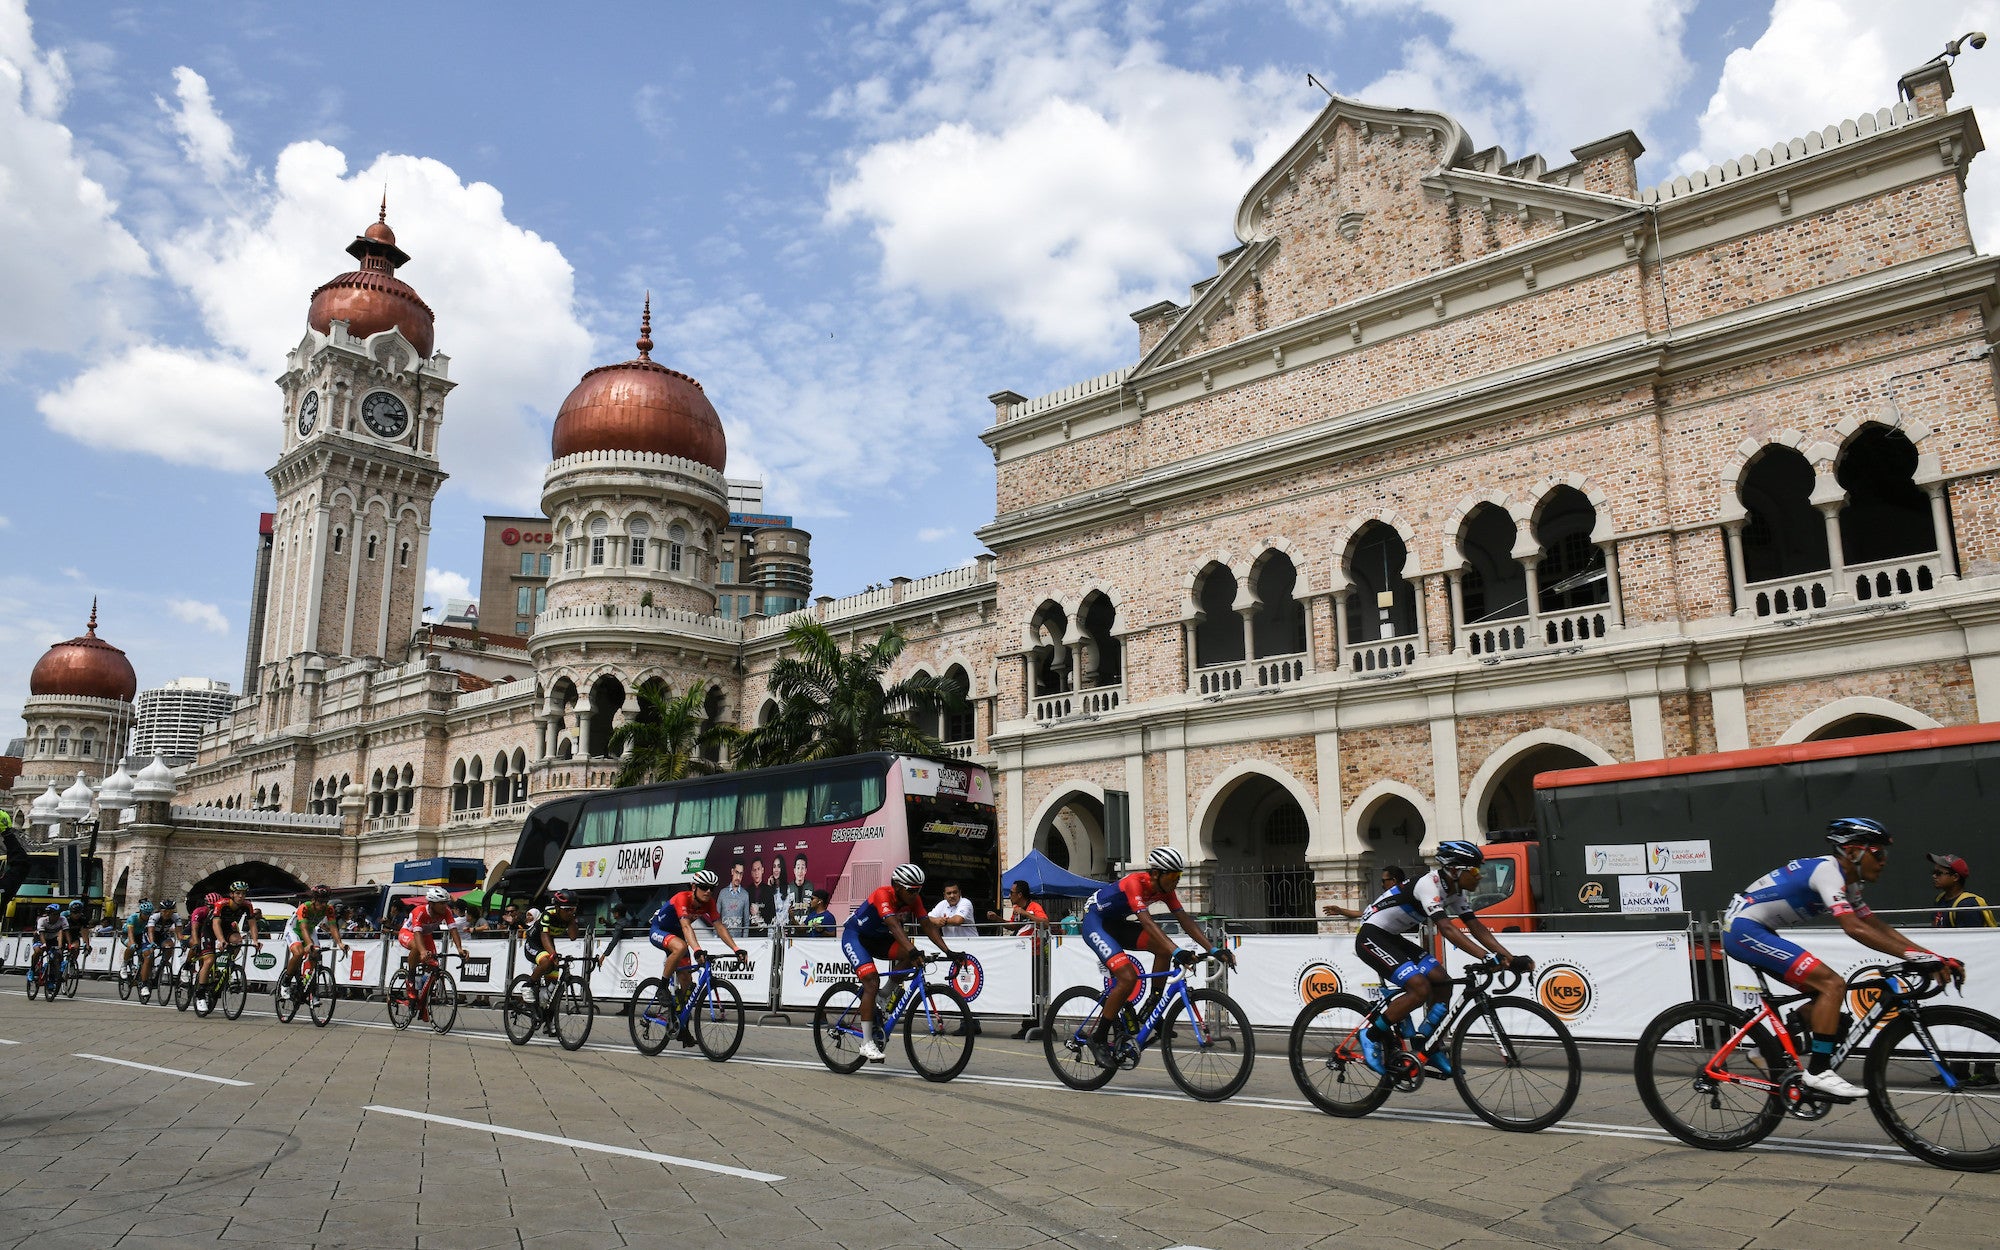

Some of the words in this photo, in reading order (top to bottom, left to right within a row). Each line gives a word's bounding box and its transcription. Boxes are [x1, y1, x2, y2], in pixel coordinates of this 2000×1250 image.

[910, 768, 929, 779] TV3
[617, 847, 651, 869] DRAMA
[1671, 851, 1706, 860] LANGKAWI
[576, 861, 597, 877] TV3
[1622, 895, 1669, 905] LANGKAWI
[1363, 938, 1399, 967] TSG
[1740, 934, 1795, 961] TSG
[464, 963, 488, 976] THULE
[1312, 983, 1335, 994] KBS
[1367, 988, 1380, 998] 194
[1553, 986, 1582, 999] KBS
[891, 988, 912, 1019] FACTOR
[1743, 992, 1758, 1004] 191
[1145, 993, 1170, 1029] FACTOR
